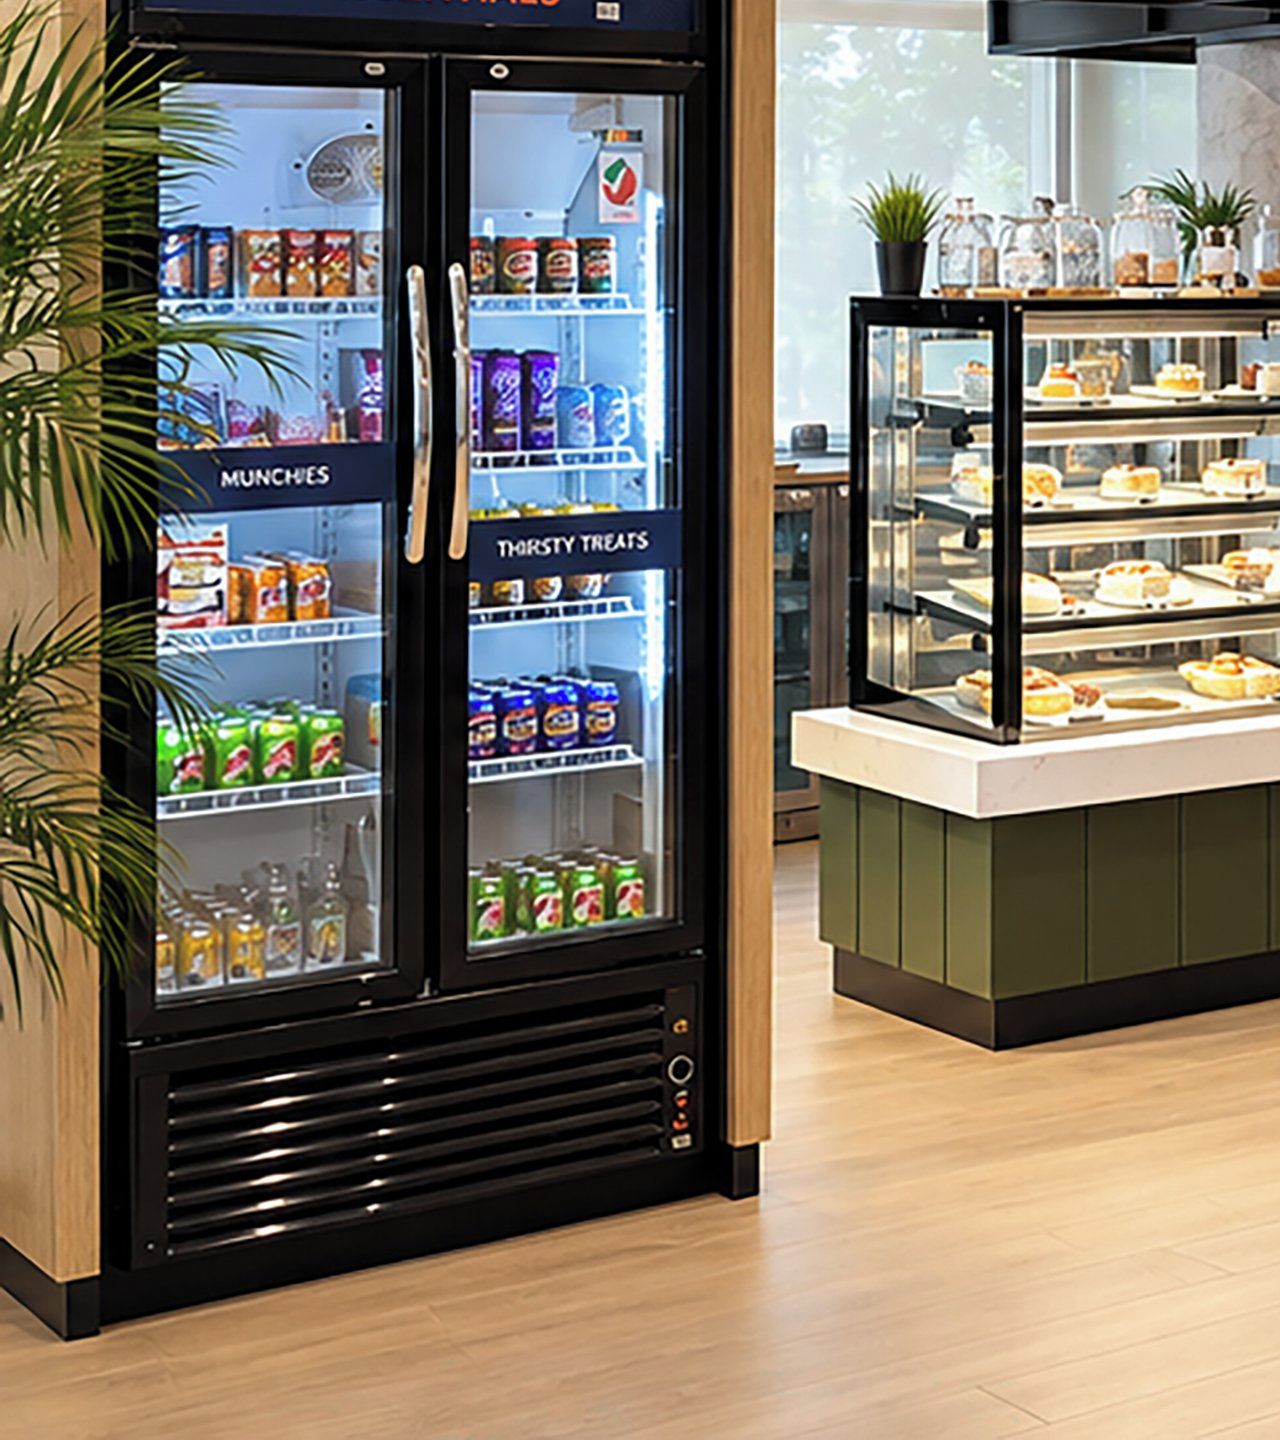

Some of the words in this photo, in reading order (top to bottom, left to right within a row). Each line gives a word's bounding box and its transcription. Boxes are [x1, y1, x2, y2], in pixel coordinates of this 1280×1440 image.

[220, 465, 330, 488] MUNCHIES
[497, 535, 576, 558] THIRSTY
[579, 530, 650, 554] TREATS
